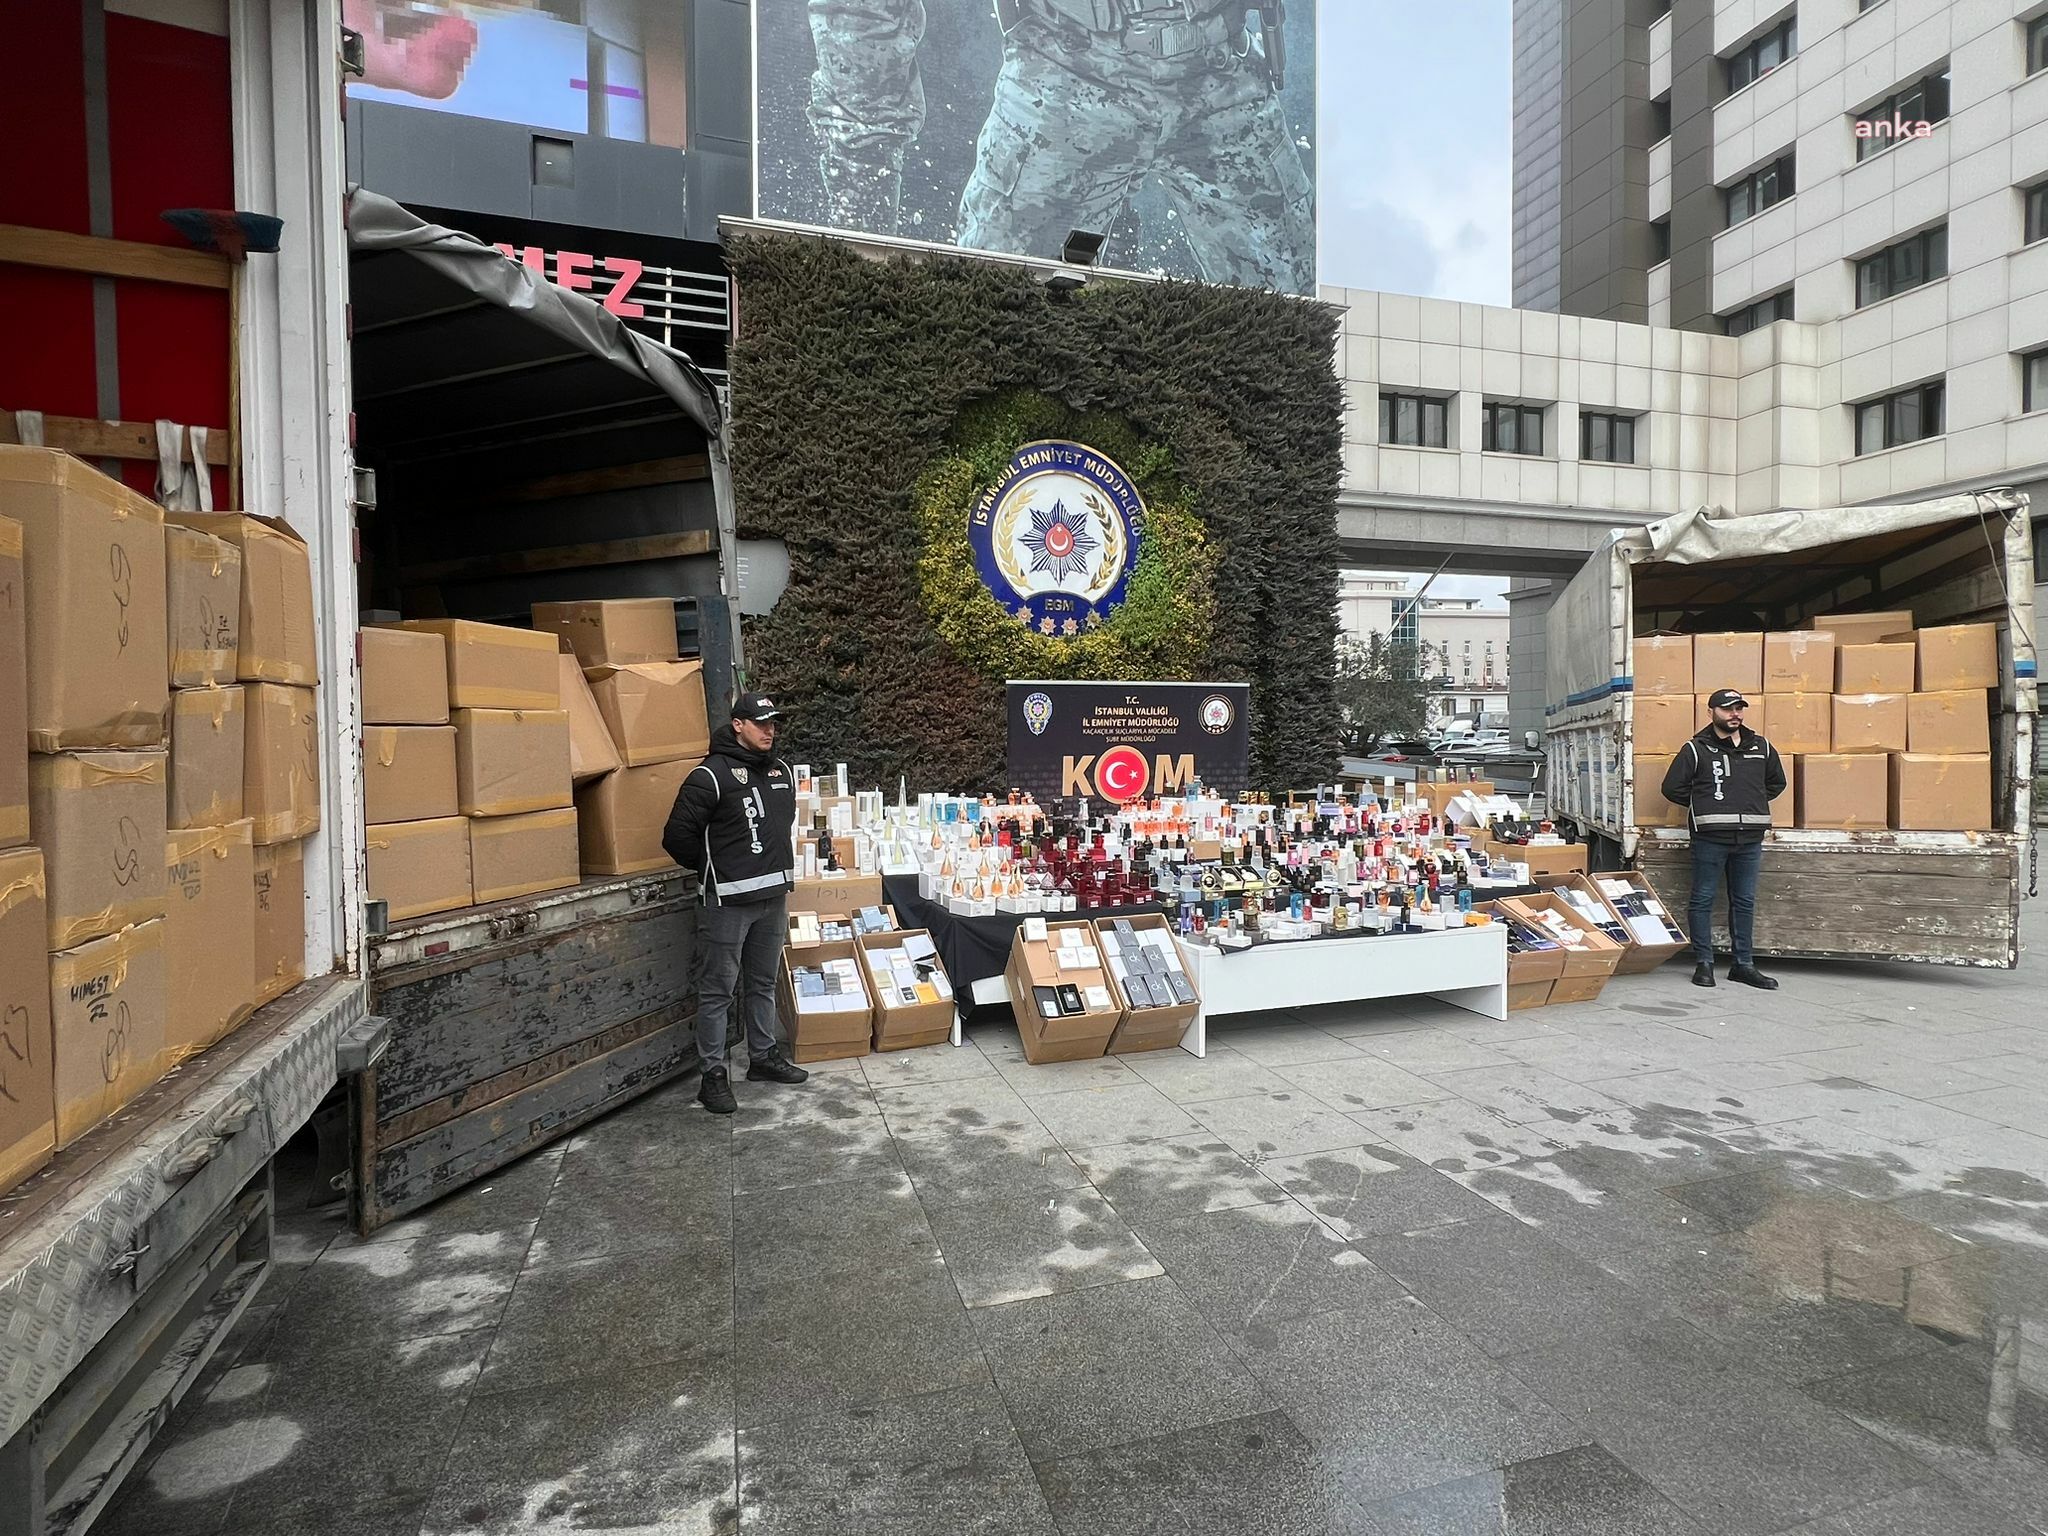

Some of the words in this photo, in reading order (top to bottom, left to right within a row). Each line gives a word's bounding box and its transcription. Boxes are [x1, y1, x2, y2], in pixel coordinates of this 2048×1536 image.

[1018, 447, 1082, 469] EMNİYET
[1045, 599, 1075, 612] EGM
[1125, 696, 1140, 705] T.C.
[1094, 705, 1134, 716] İSTANBUL
[1135, 705, 1168, 716] VALİLİĞİ
[1091, 717, 1127, 727] EMNİYET
[1127, 716, 1179, 727] MÜDÜRLÜĞÜ
